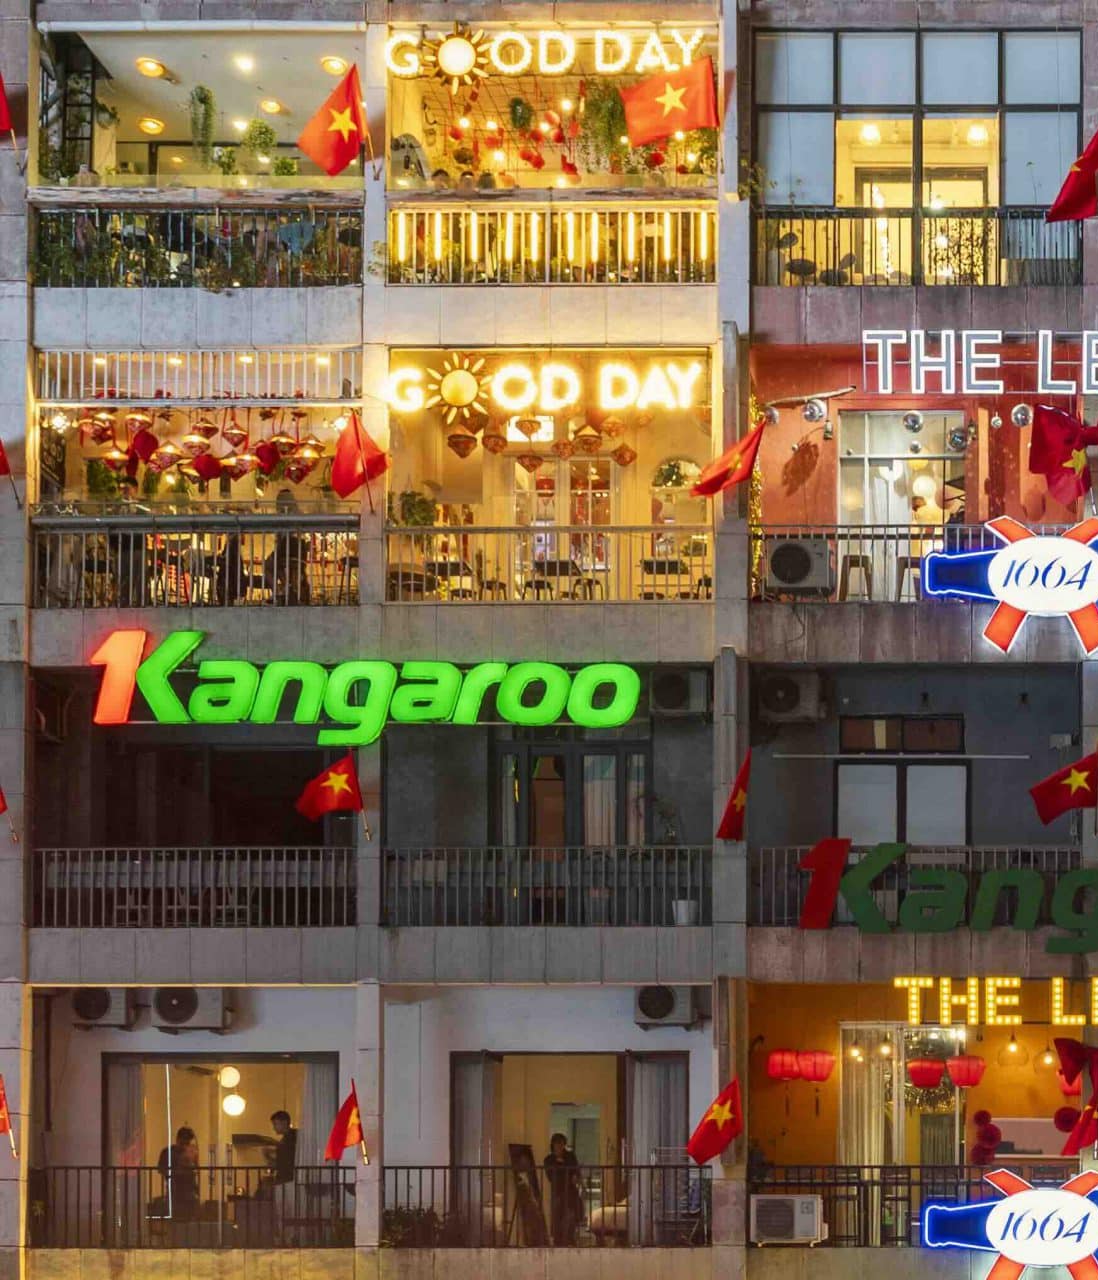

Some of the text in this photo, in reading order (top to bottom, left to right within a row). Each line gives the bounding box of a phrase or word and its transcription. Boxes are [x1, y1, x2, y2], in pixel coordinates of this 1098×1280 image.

[594, 28, 705, 73] DAY
[598, 362, 701, 409] DAY
[862, 329, 1003, 394] THE
[894, 976, 1023, 1025] THE
